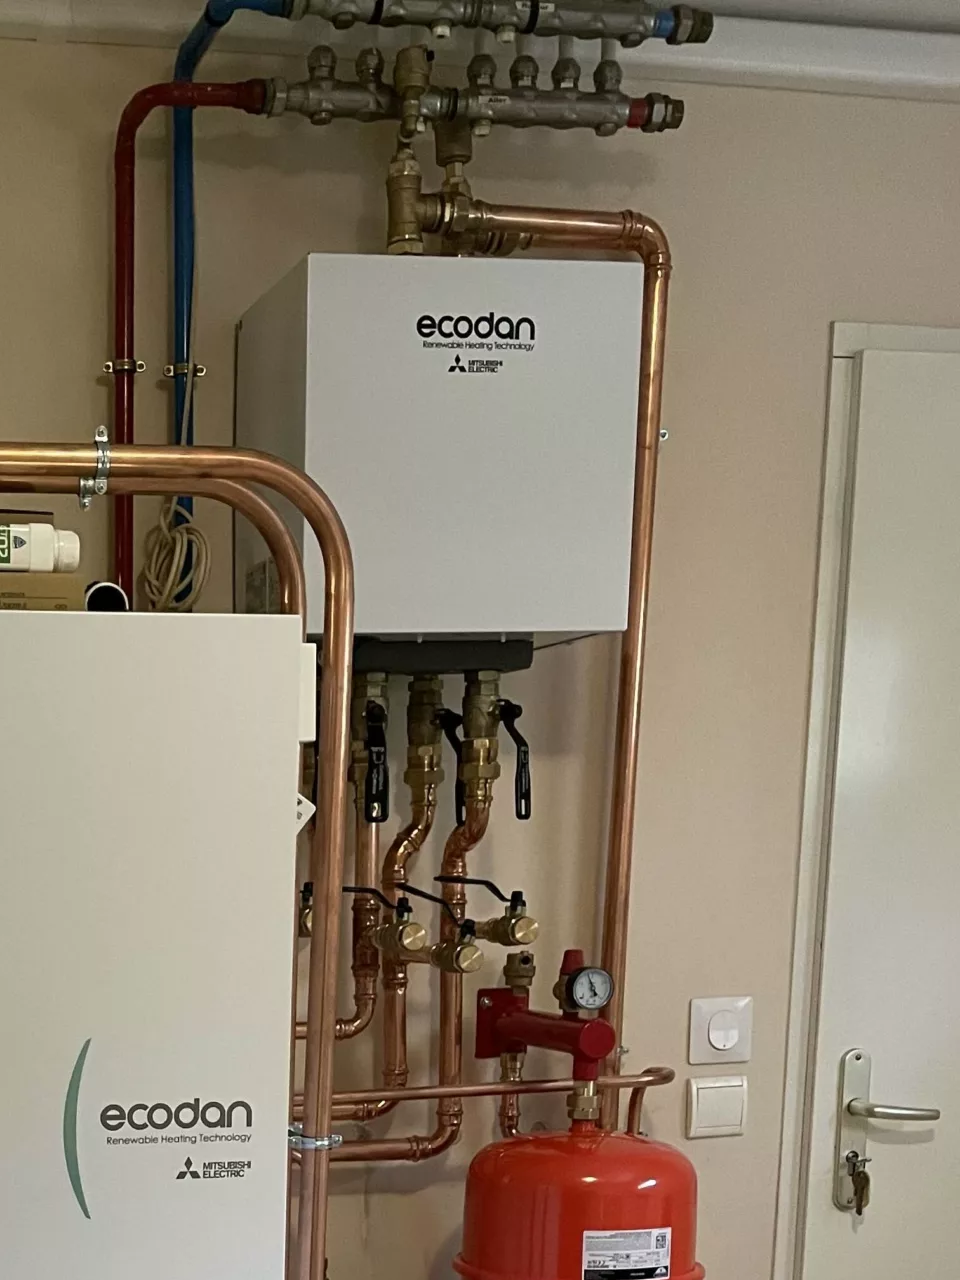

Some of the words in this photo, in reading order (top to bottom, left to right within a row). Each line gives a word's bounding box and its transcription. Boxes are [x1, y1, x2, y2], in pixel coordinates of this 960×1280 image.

[416, 312, 535, 340] ecodan
[422, 340, 464, 349] Renewable
[465, 341, 493, 351] Heating
[494, 342, 535, 352] Technology
[100, 1098, 252, 1131] ecodan
[106, 1136, 159, 1145] Renewable
[161, 1135, 197, 1145] Heating
[199, 1133, 252, 1143] Technology
[203, 1161, 251, 1170] MITSUBISHI
[203, 1170, 245, 1178] ELECTRIC
